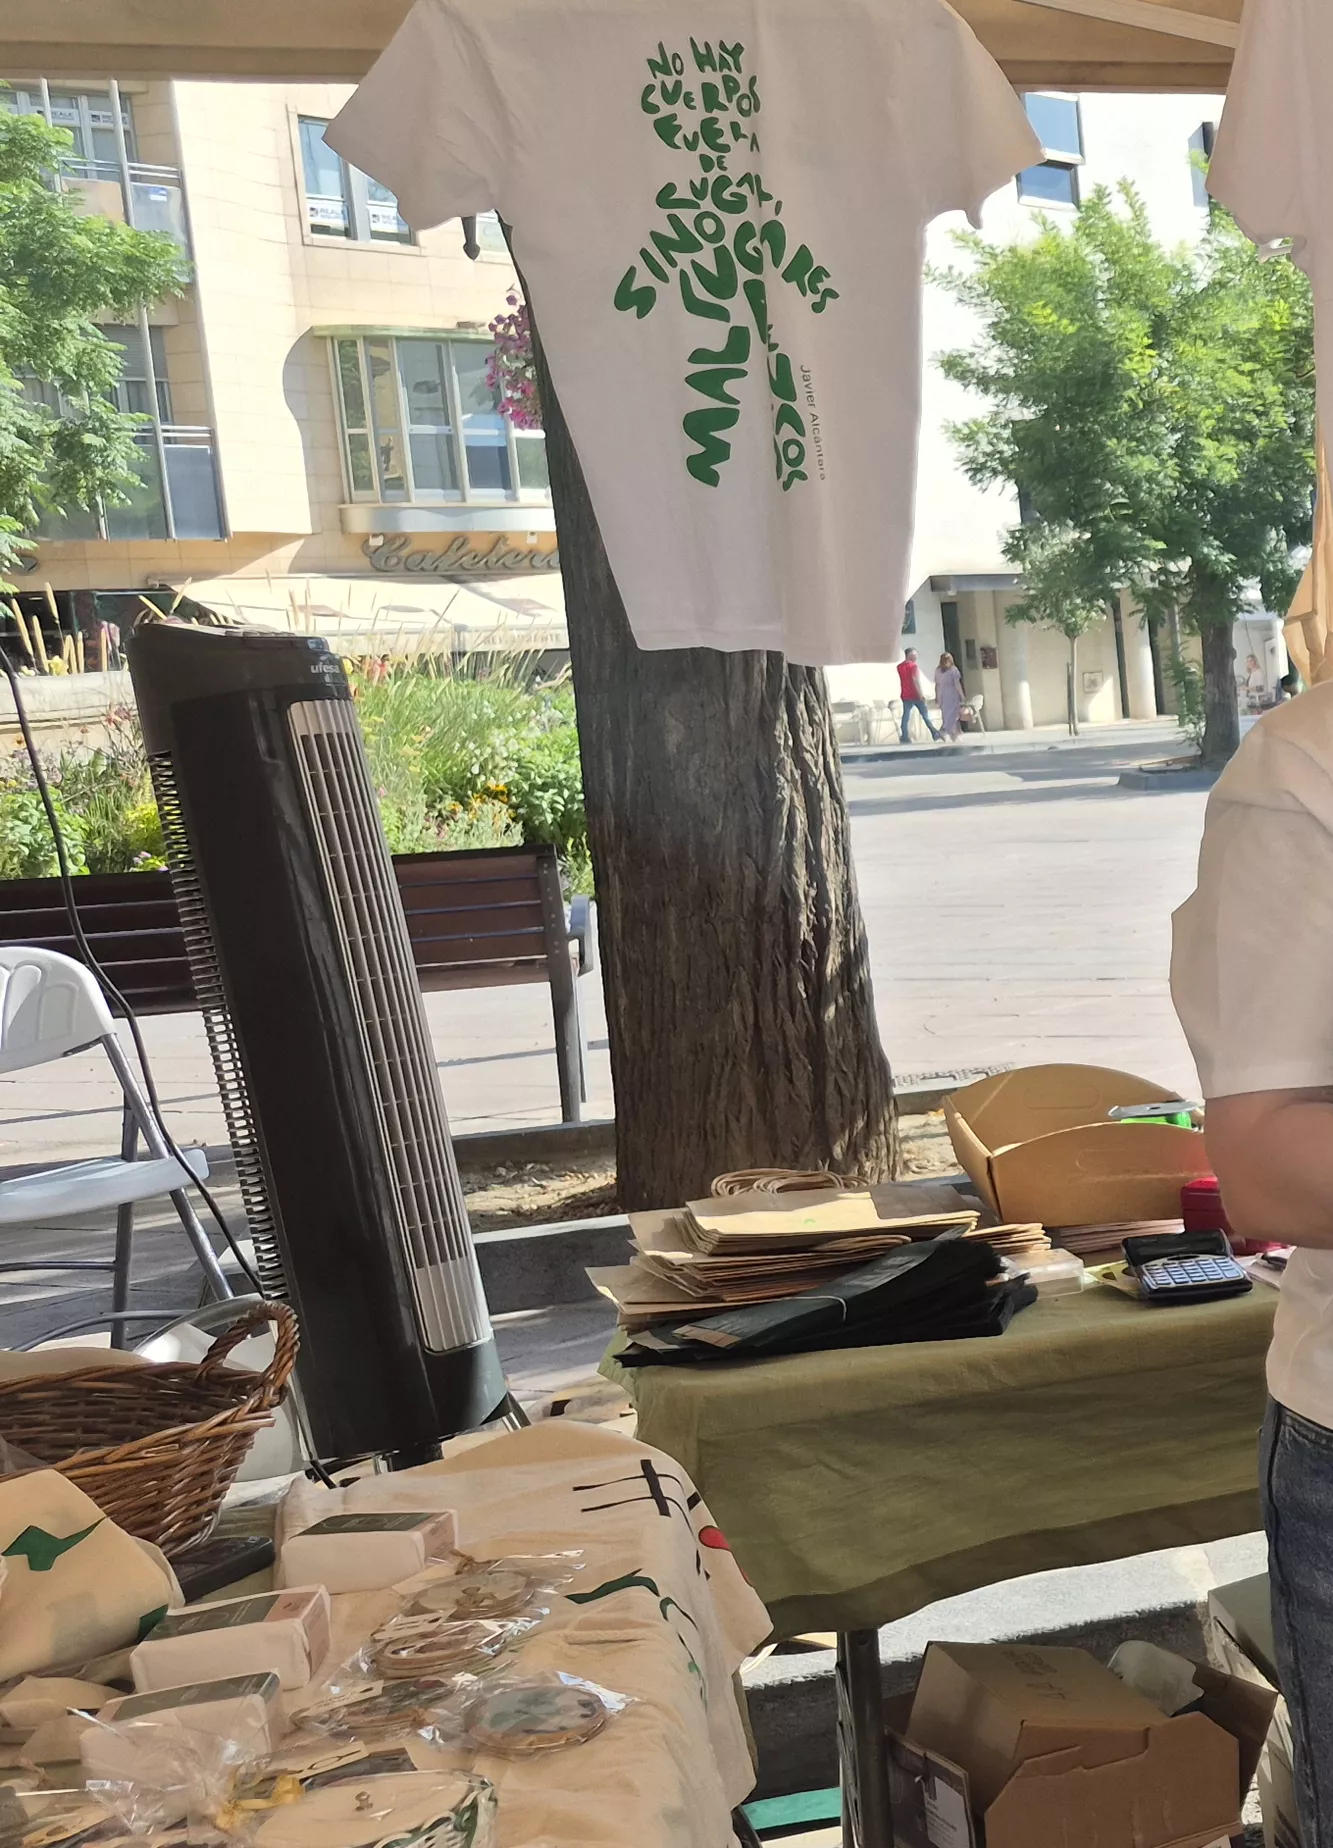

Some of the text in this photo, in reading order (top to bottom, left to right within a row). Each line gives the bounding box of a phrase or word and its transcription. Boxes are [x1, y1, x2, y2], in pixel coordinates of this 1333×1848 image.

[646, 35, 745, 80] NO HAY
[640, 74, 761, 118] CUERPOS
[653, 112, 761, 154] FUERA
[699, 153, 729, 174] DE
[613, 210, 727, 320] SINO
[682, 324, 752, 488] MAL
[800, 364, 817, 409] Javier
[310, 661, 341, 674] ufesa
